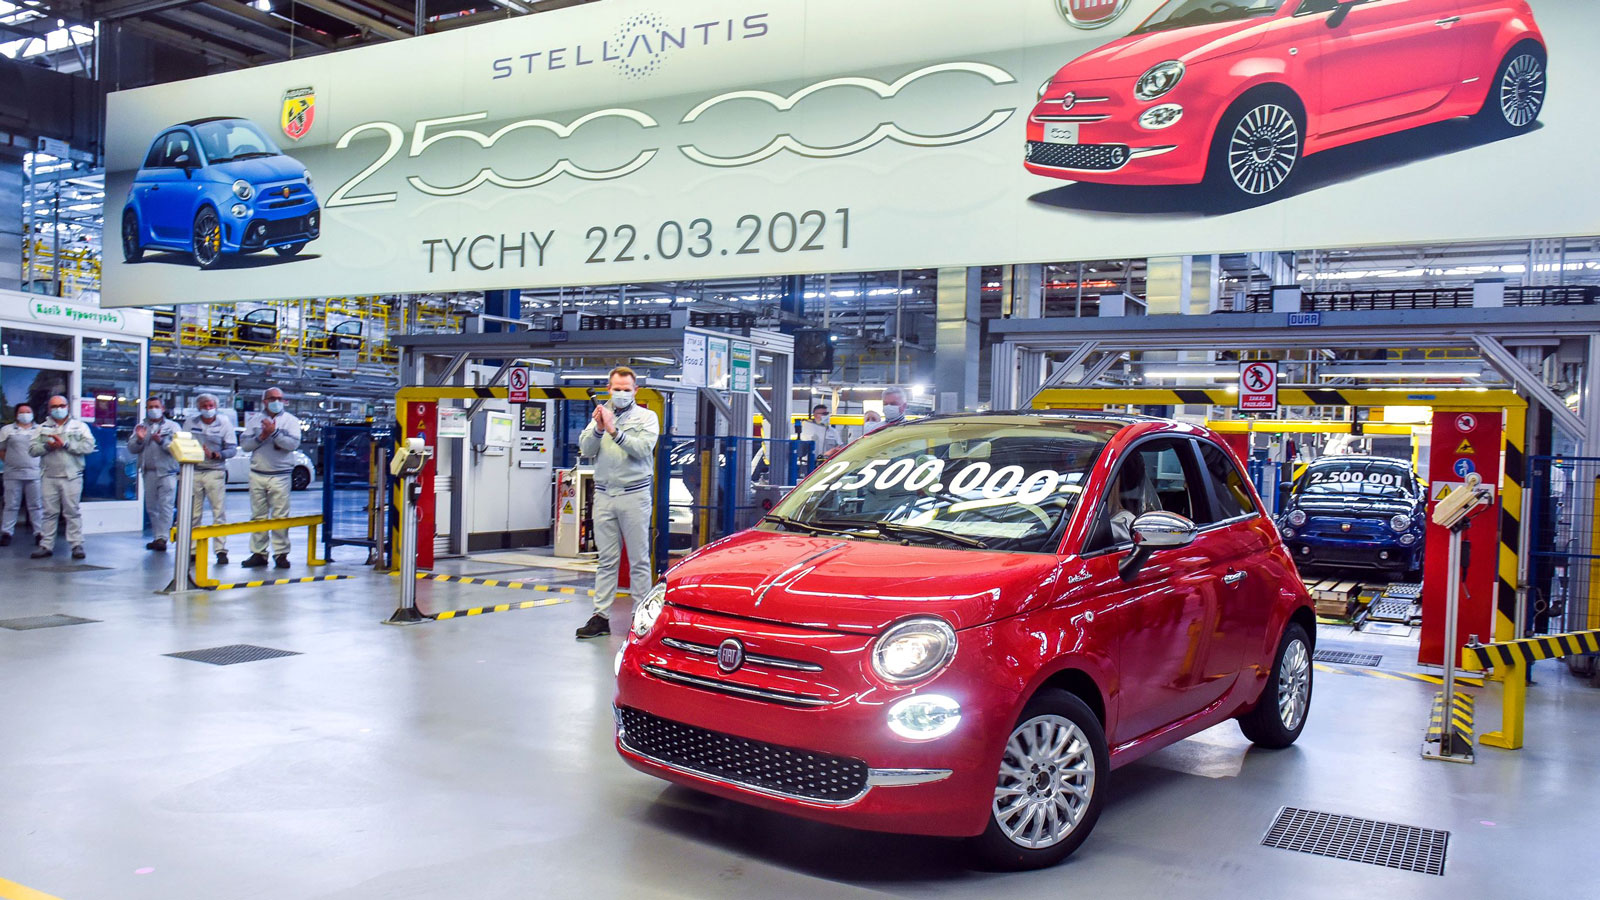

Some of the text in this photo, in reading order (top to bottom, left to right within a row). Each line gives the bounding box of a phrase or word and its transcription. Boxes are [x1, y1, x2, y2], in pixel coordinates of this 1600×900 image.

[492, 13, 769, 80] STELLANTIS
[422, 207, 851, 274] TYCHY 22.03.2021
[805, 458, 1059, 505] 2.500.000
[1310, 471, 1403, 488] 2.500.001
[722, 647, 737, 663] FIAT
